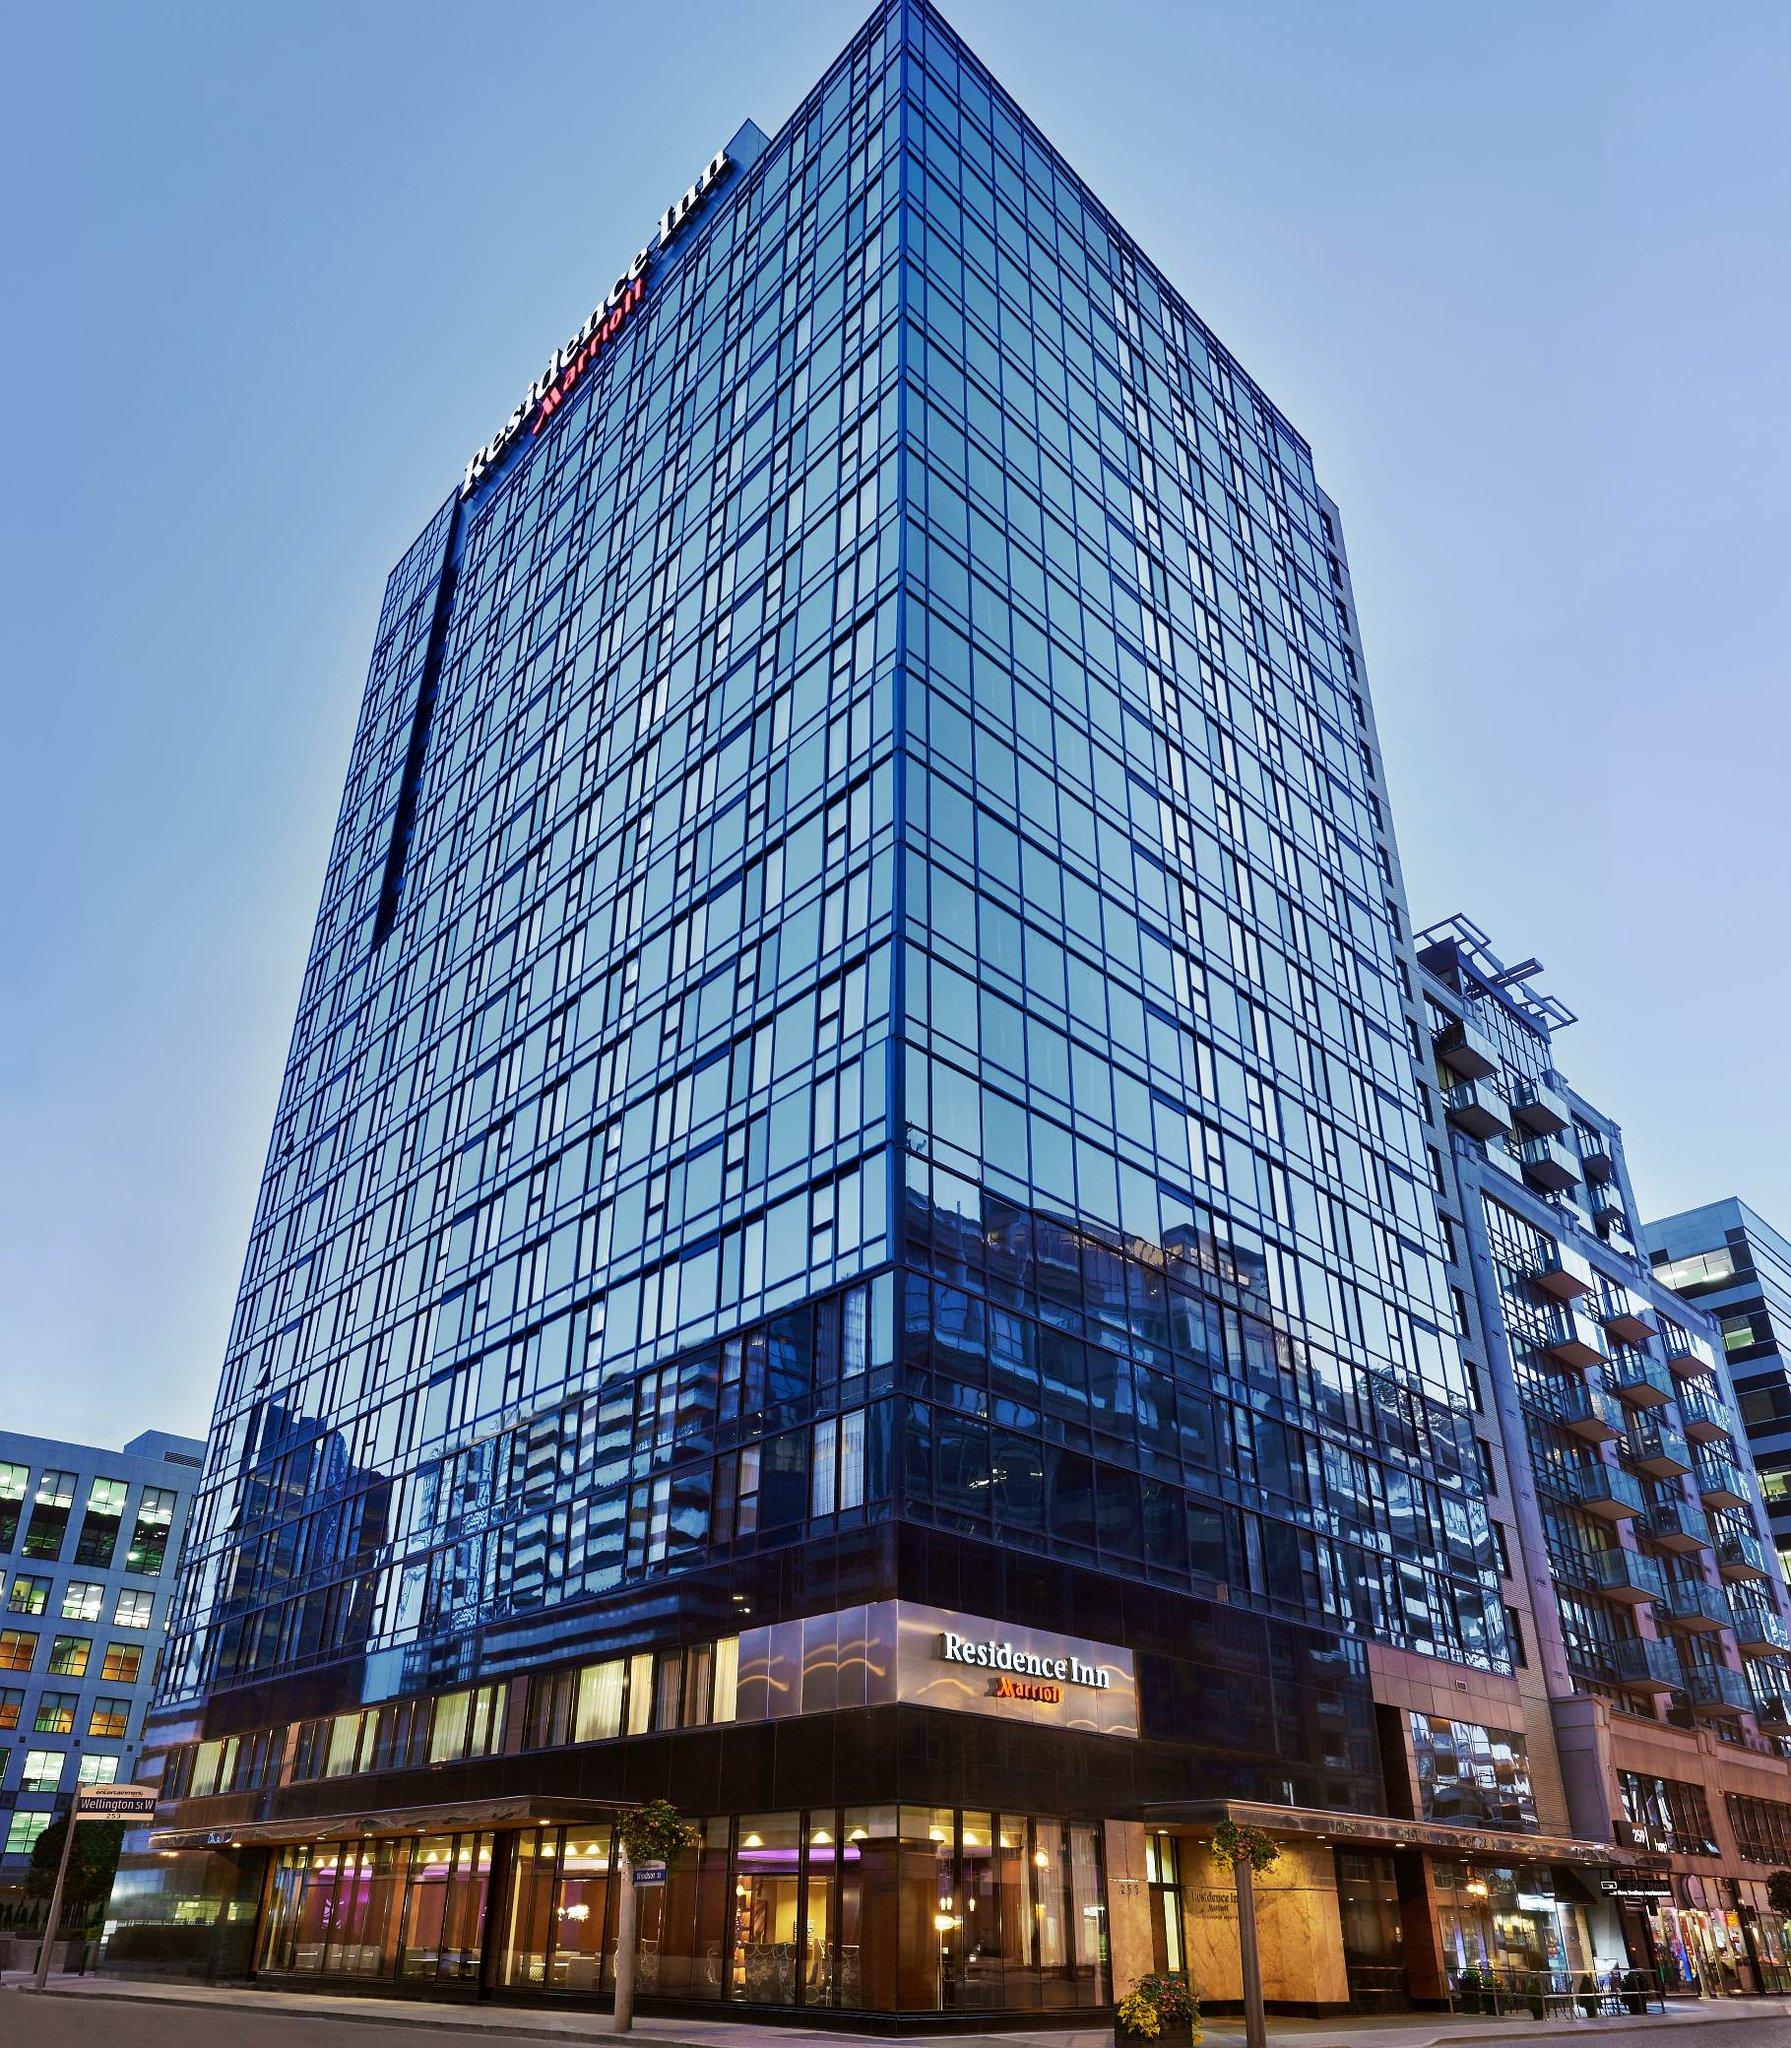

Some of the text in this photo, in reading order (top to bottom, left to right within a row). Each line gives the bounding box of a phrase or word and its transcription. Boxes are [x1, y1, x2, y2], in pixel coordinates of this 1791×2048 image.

[461, 150, 729, 498] Residence Inn
[532, 278, 646, 435] Marriott
[943, 1632, 1110, 1688] Residence Inn
[81, 1799, 134, 1811] Wellington
[145, 1800, 154, 1809] W
[1191, 1891, 1230, 1903] Residence
